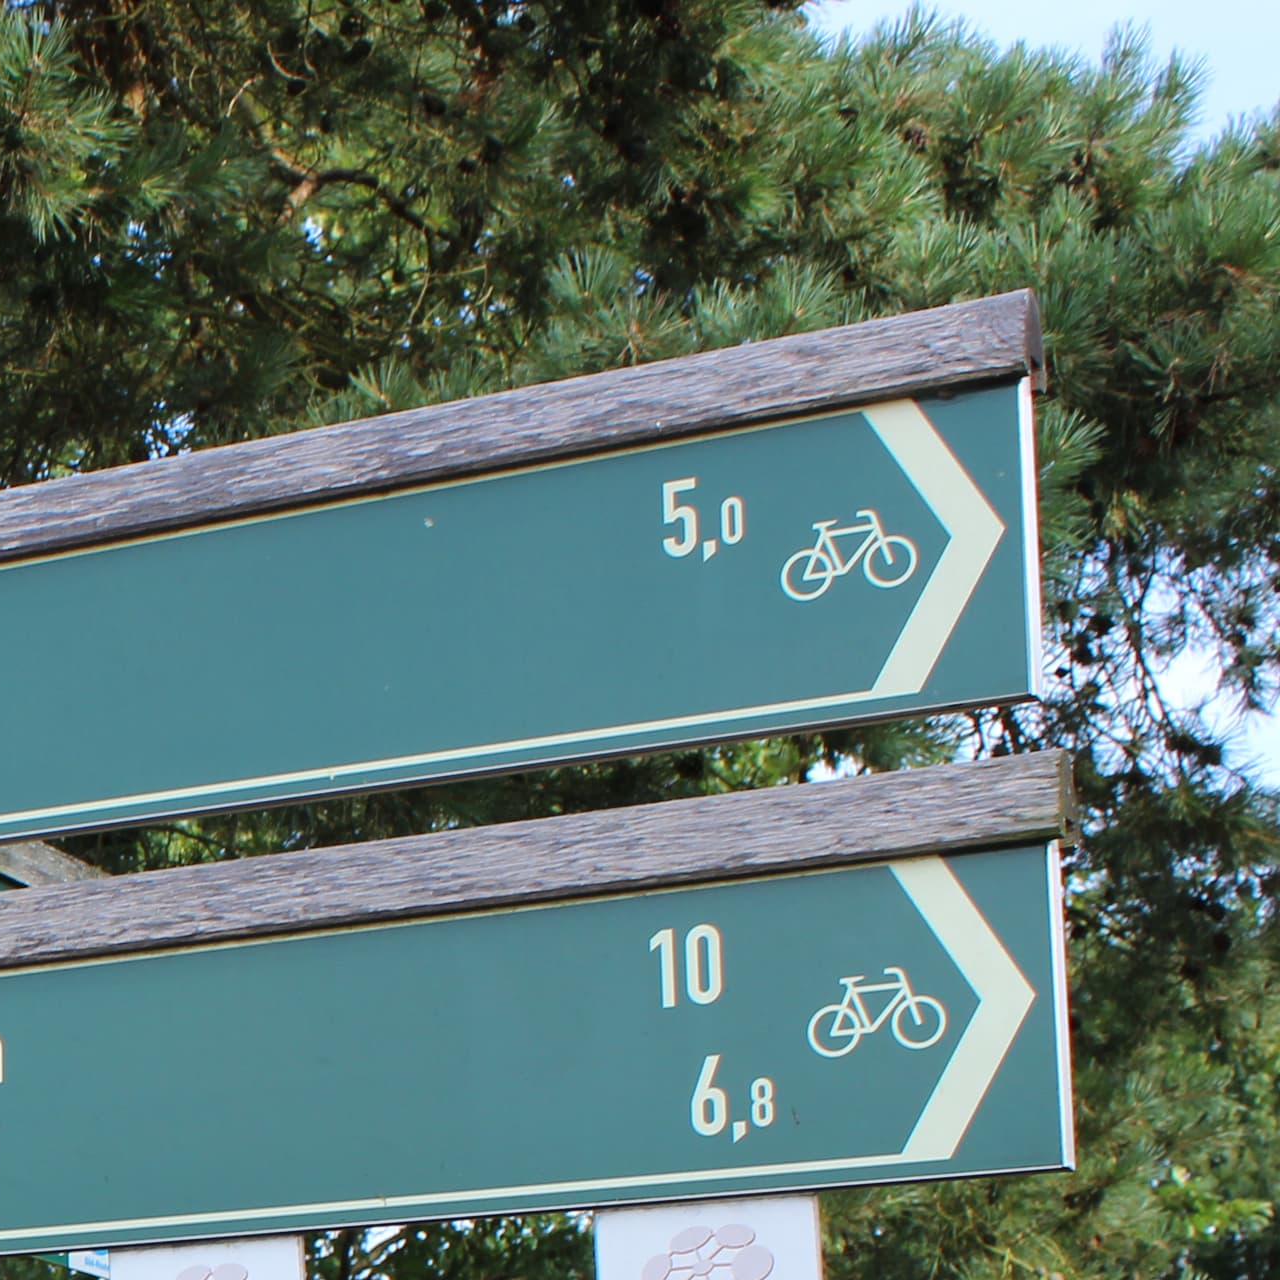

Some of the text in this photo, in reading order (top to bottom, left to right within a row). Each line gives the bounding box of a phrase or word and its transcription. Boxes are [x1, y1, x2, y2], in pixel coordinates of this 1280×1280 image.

[661, 476, 744, 563] 5,0
[648, 923, 723, 1010] 10
[689, 1054, 776, 1142] 6,8
